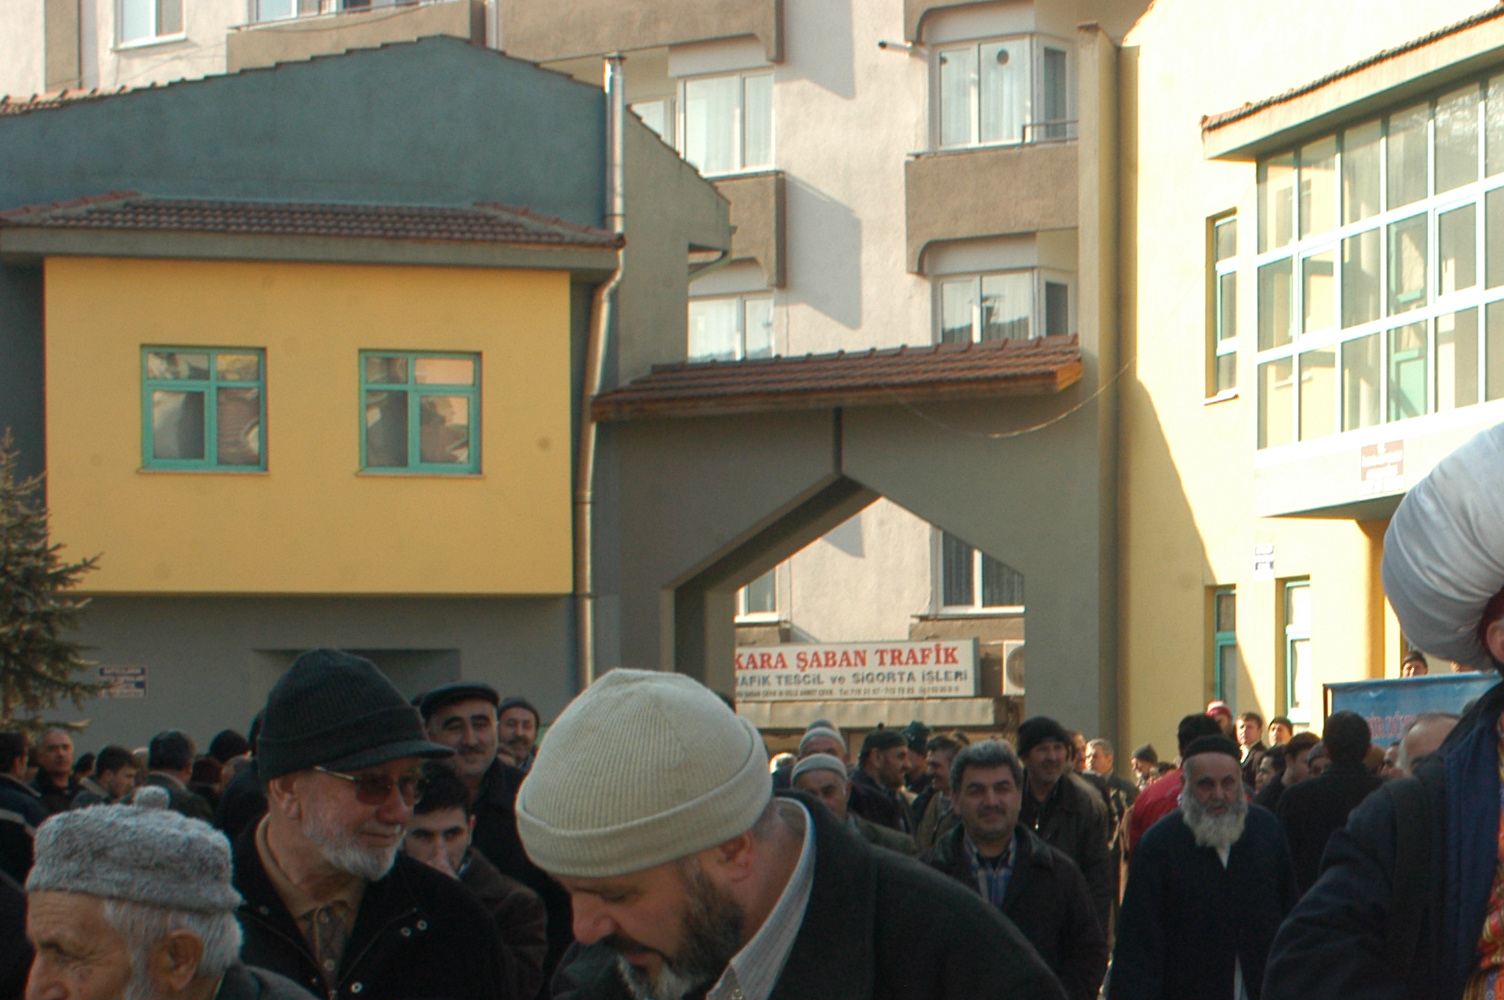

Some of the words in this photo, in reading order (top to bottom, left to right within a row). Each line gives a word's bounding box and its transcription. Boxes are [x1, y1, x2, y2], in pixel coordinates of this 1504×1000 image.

[796, 650, 867, 672] ŞABAN
[874, 644, 958, 666] TRAFİK
[735, 674, 771, 687] AFİK
[829, 674, 846, 686] ve
[851, 671, 917, 685] SİGORTA
